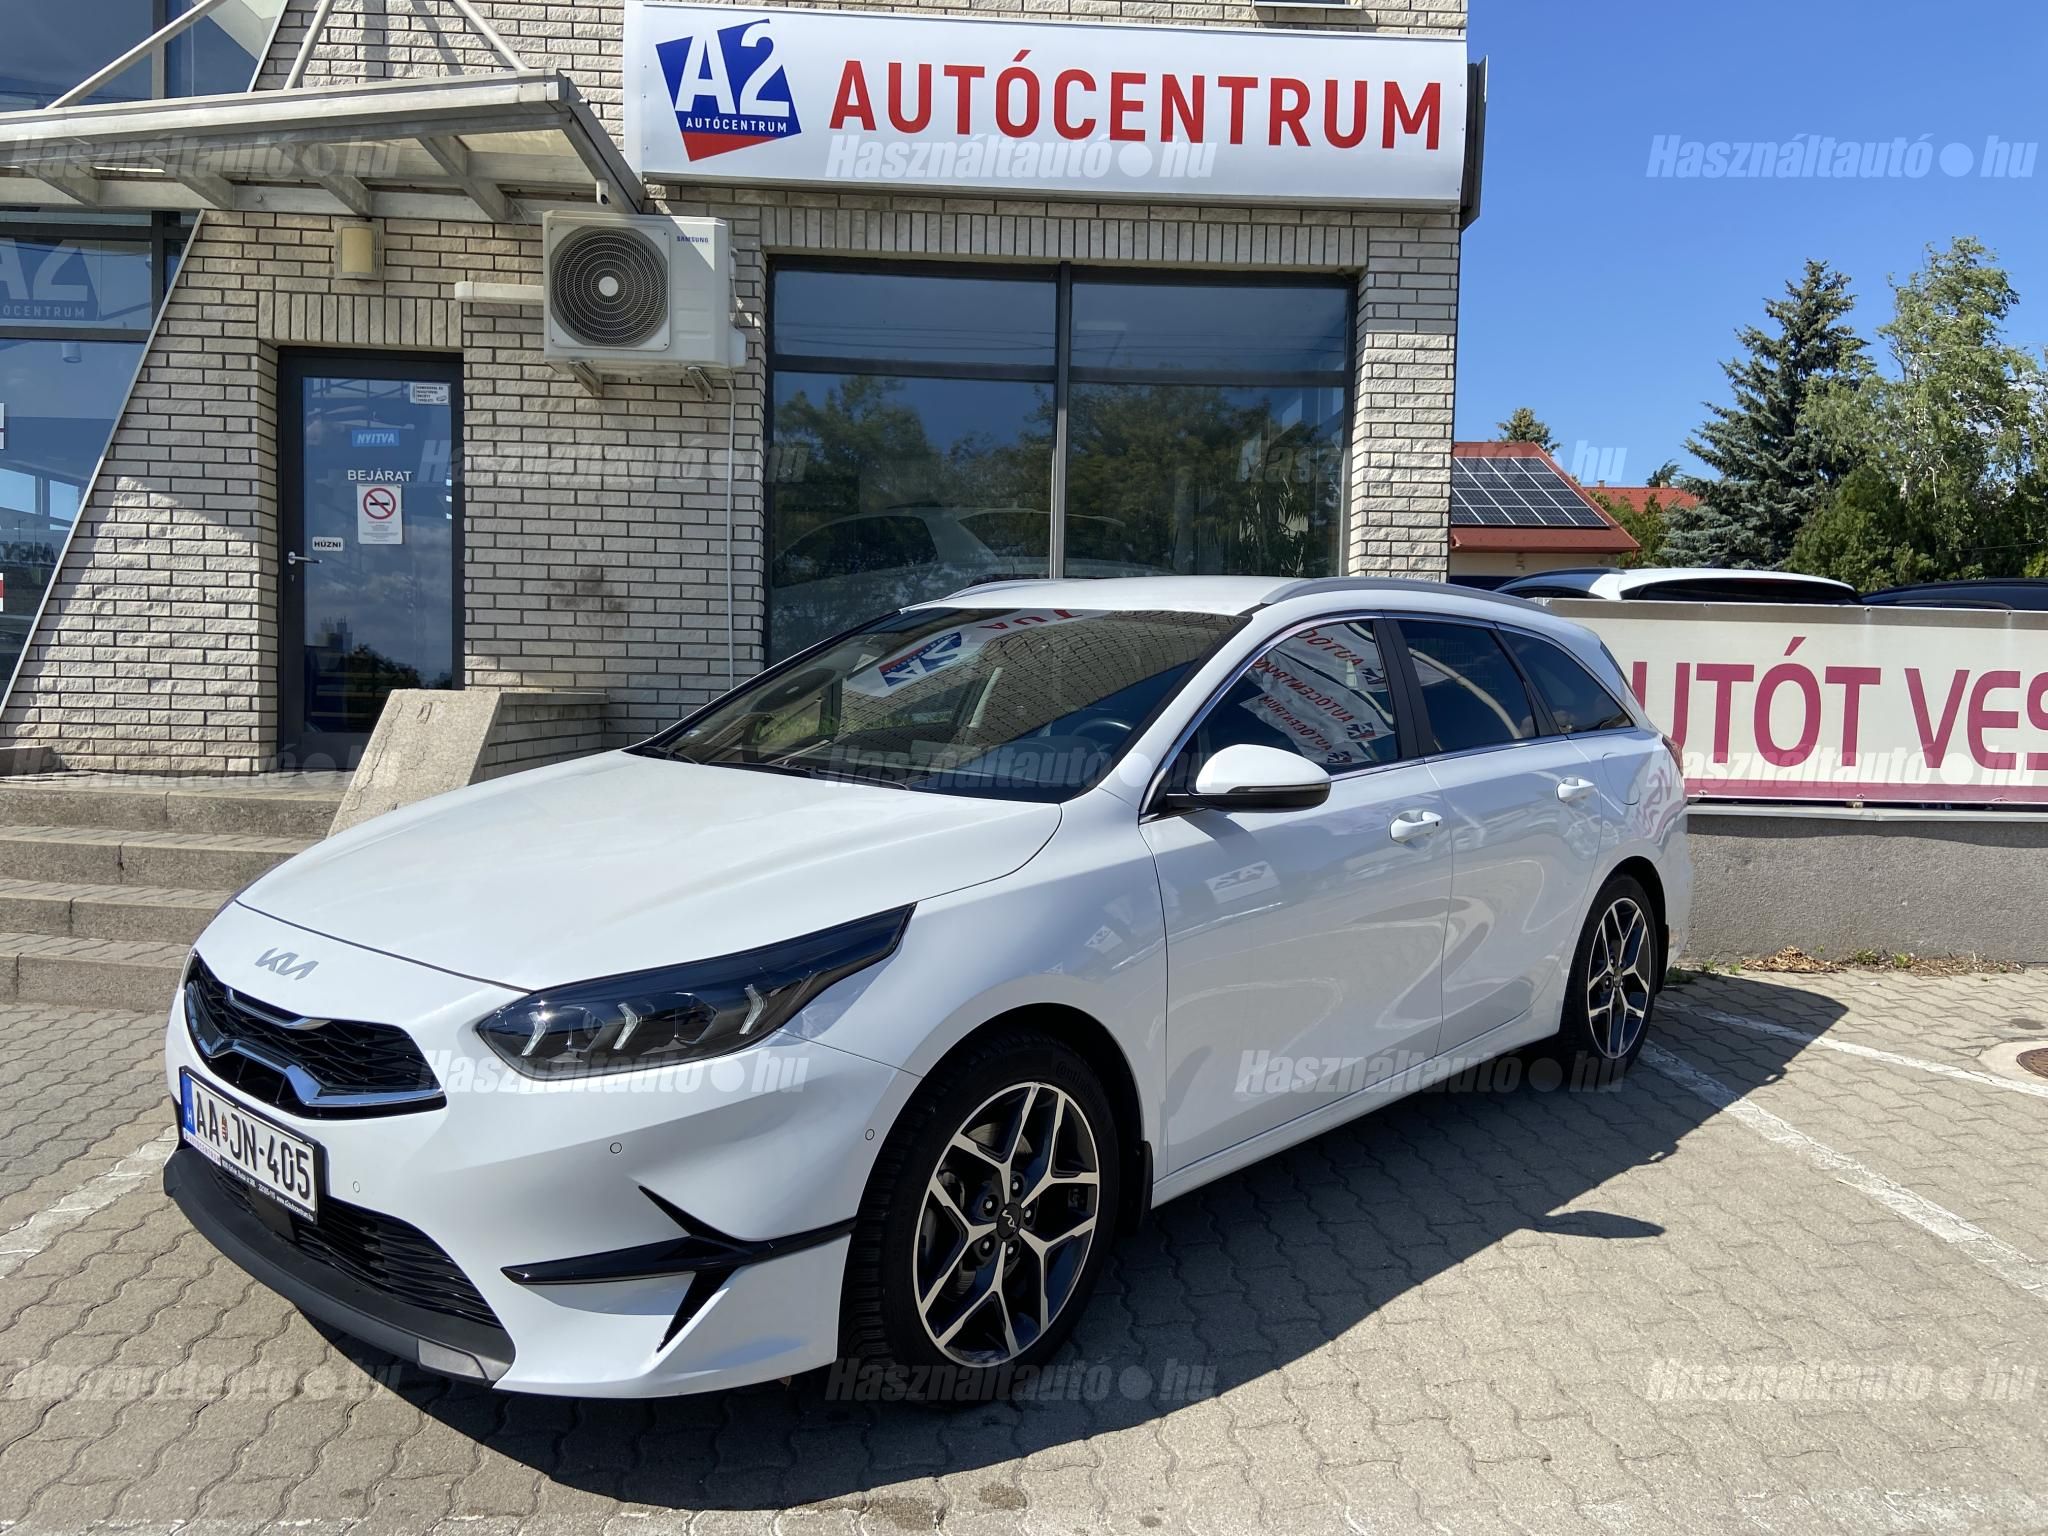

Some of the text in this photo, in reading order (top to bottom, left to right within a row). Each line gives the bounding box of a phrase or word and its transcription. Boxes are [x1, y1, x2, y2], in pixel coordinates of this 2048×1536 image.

[674, 22, 789, 117] A2
[829, 49, 1441, 150] AUTÓCENTRUM
[686, 116, 787, 133] AUTÓCENTRUM
[356, 432, 395, 445] NYITVA
[347, 467, 412, 482] BEJÁRAT
